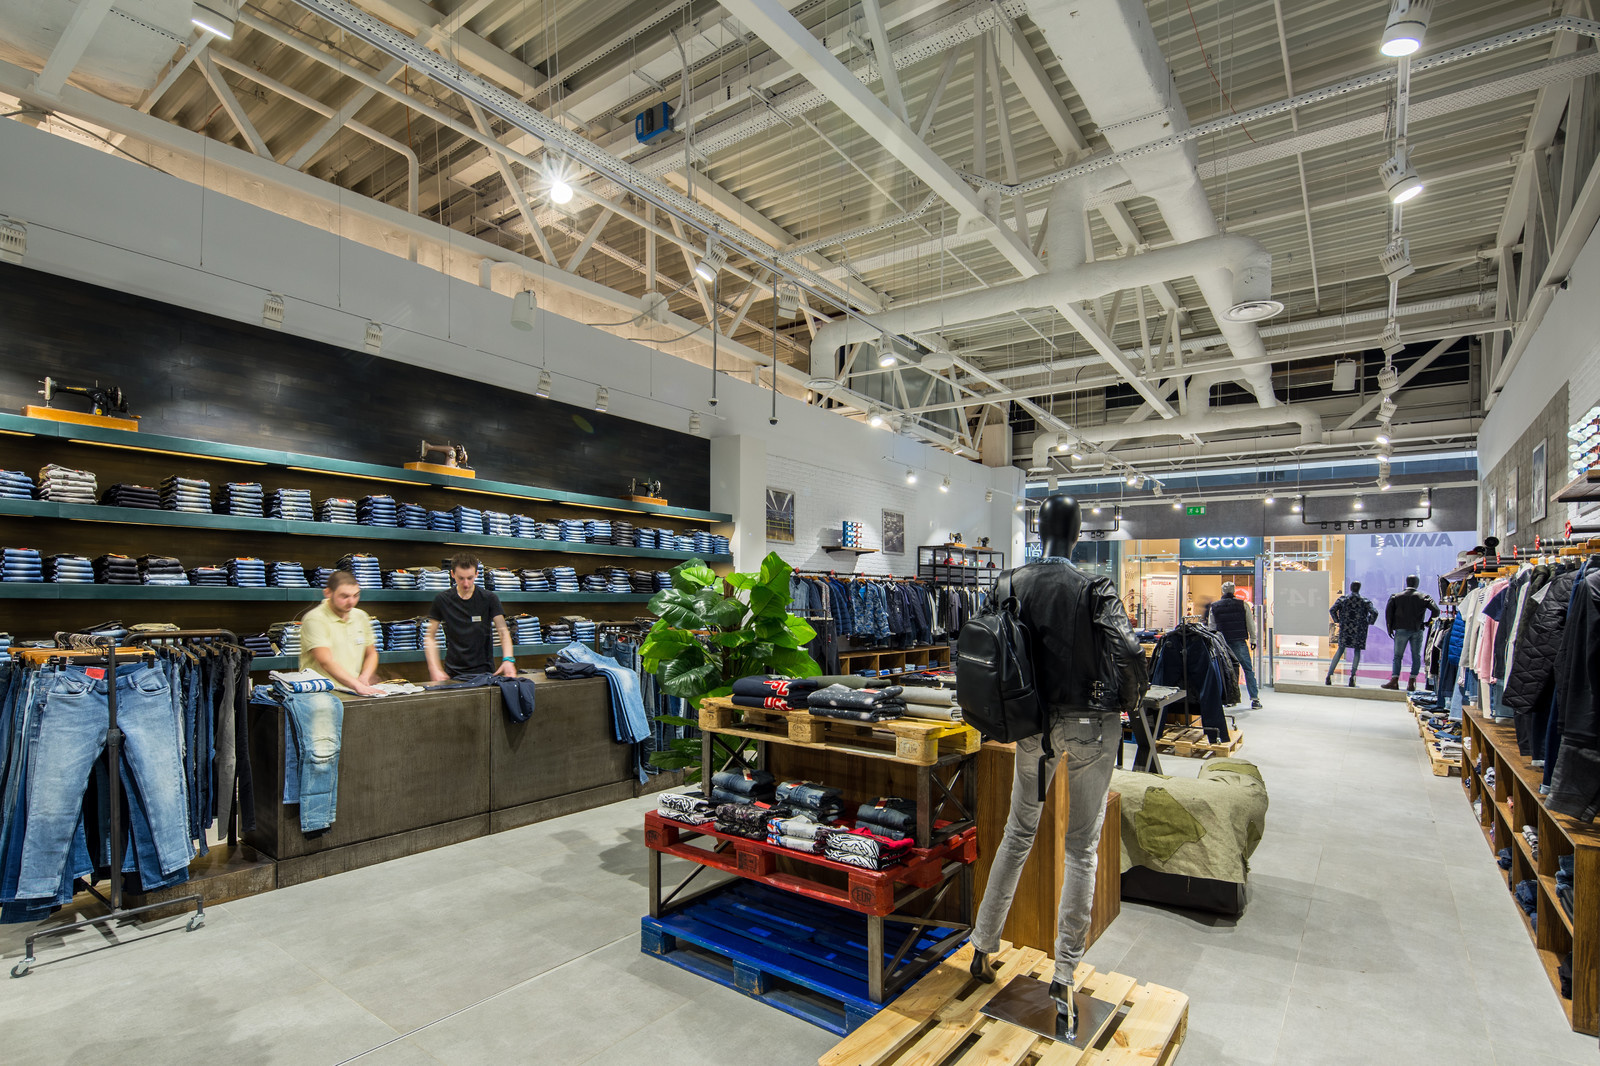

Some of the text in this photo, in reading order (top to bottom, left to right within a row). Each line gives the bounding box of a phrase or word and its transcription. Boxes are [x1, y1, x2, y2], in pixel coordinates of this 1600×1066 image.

[1193, 536, 1249, 549] ecco
[1370, 533, 1453, 548] LAVINA
[856, 890, 872, 904] EUR
